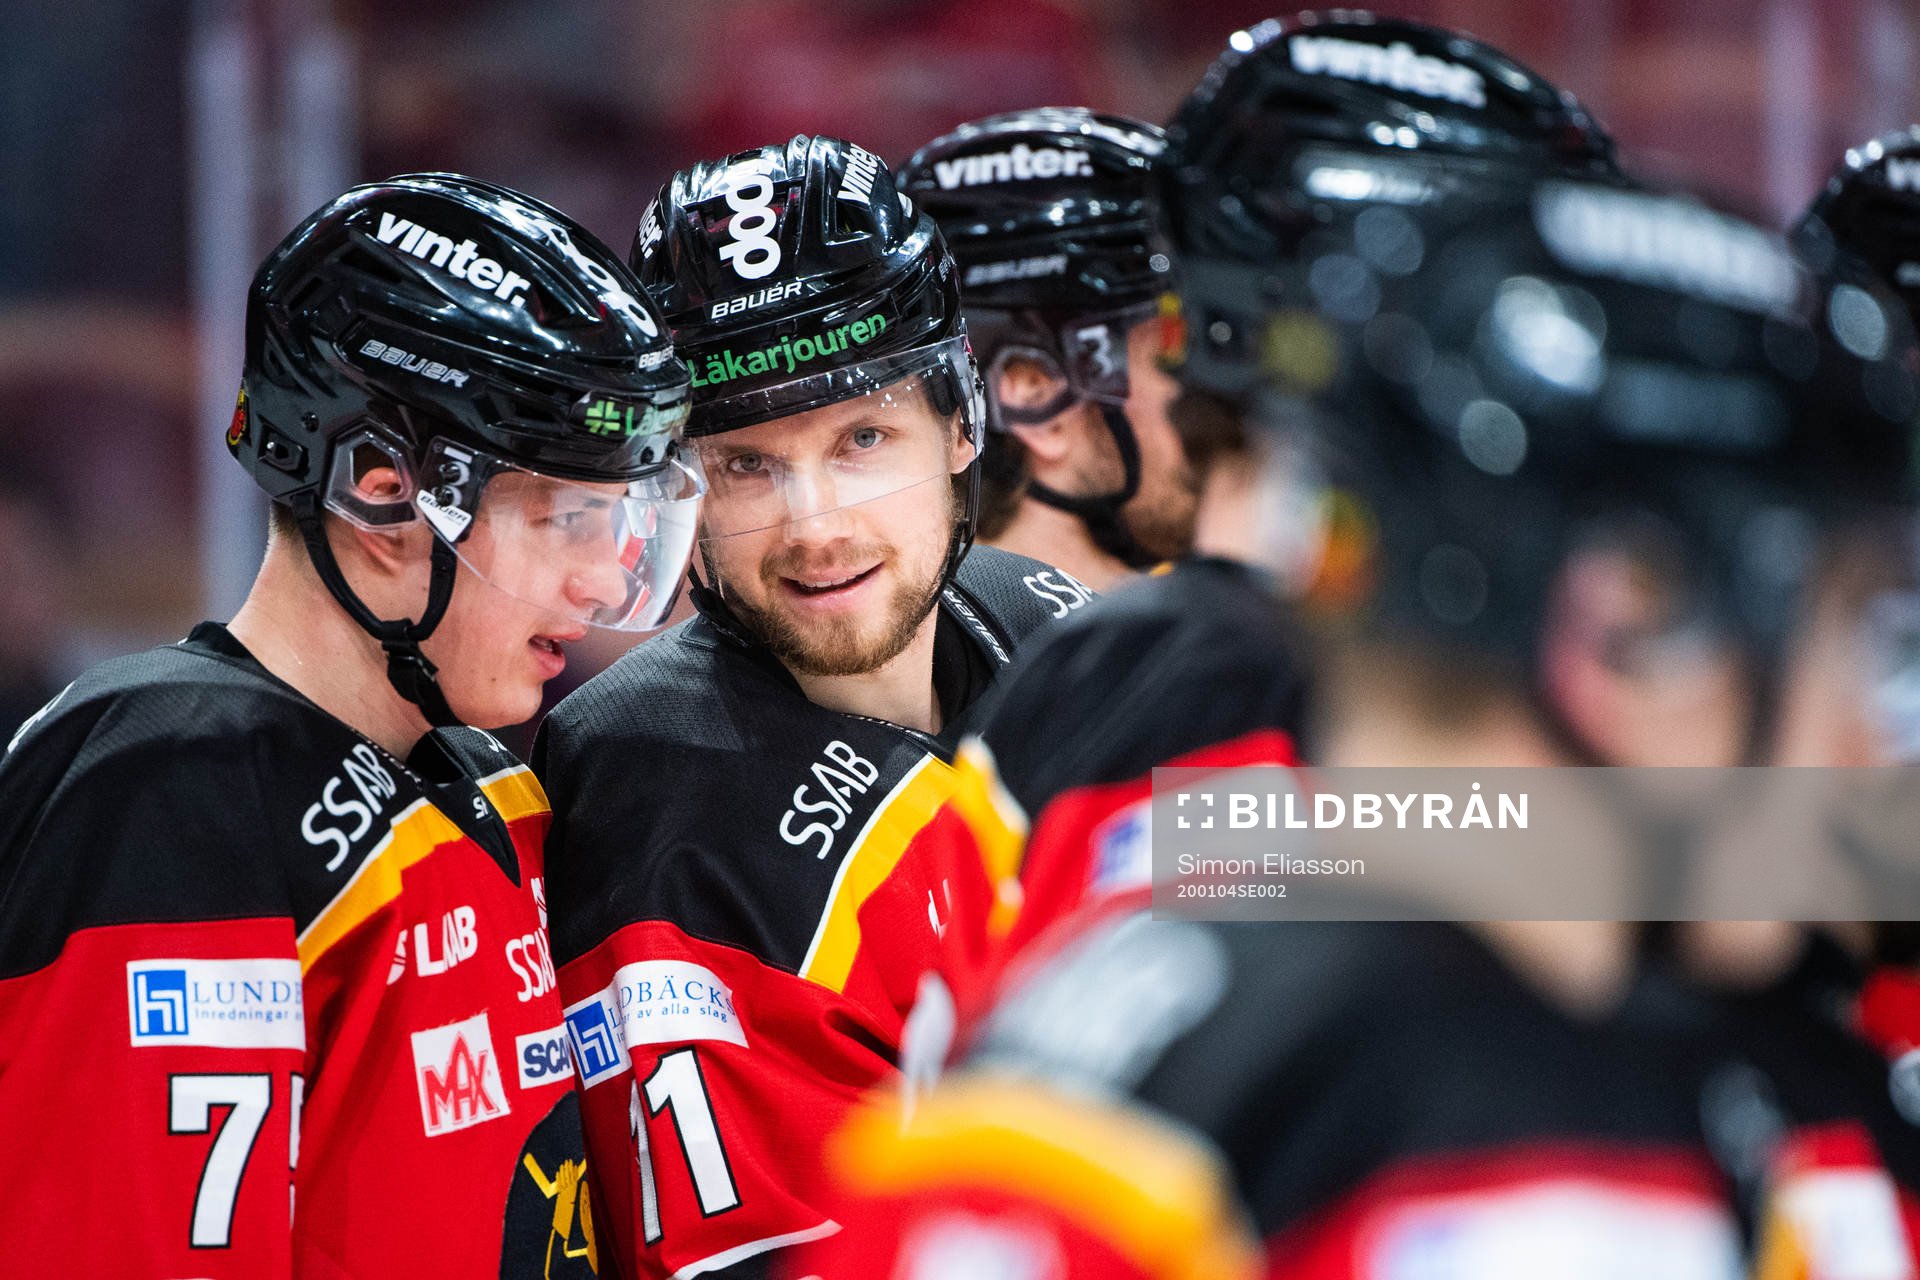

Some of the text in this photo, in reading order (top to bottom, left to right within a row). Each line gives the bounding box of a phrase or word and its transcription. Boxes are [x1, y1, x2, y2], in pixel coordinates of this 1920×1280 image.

[376, 212, 532, 308] vinter.
[686, 313, 887, 388] Läkarjouren
[301, 744, 397, 872] SSAB
[779, 740, 879, 860] SSAB
[524, 1035, 571, 1078] SCA
